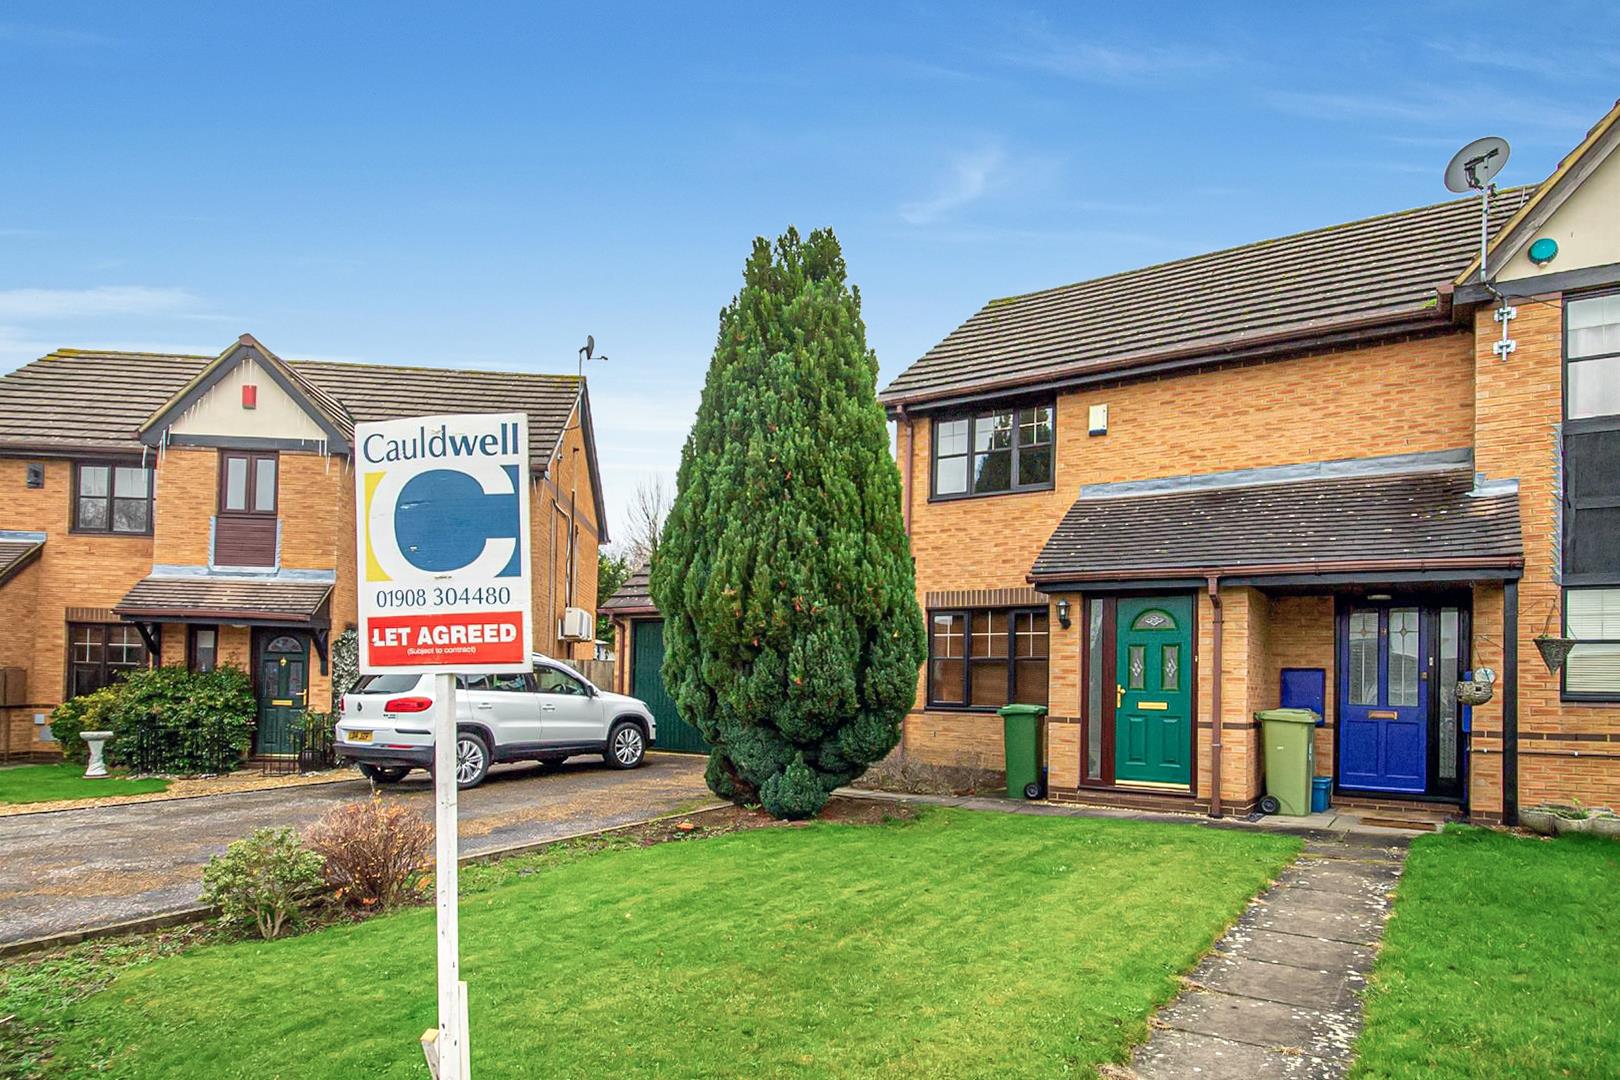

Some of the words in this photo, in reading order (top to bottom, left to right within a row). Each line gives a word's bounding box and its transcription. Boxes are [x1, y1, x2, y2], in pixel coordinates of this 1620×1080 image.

[363, 422, 519, 464] Cauldwell
[376, 588, 427, 608] 01908
[433, 586, 511, 607] 304480
[372, 627, 411, 647] LET
[417, 623, 517, 646] AGREED
[407, 647, 434, 656] (Subject
[435, 647, 443, 655] to
[444, 646, 477, 655] contract)
